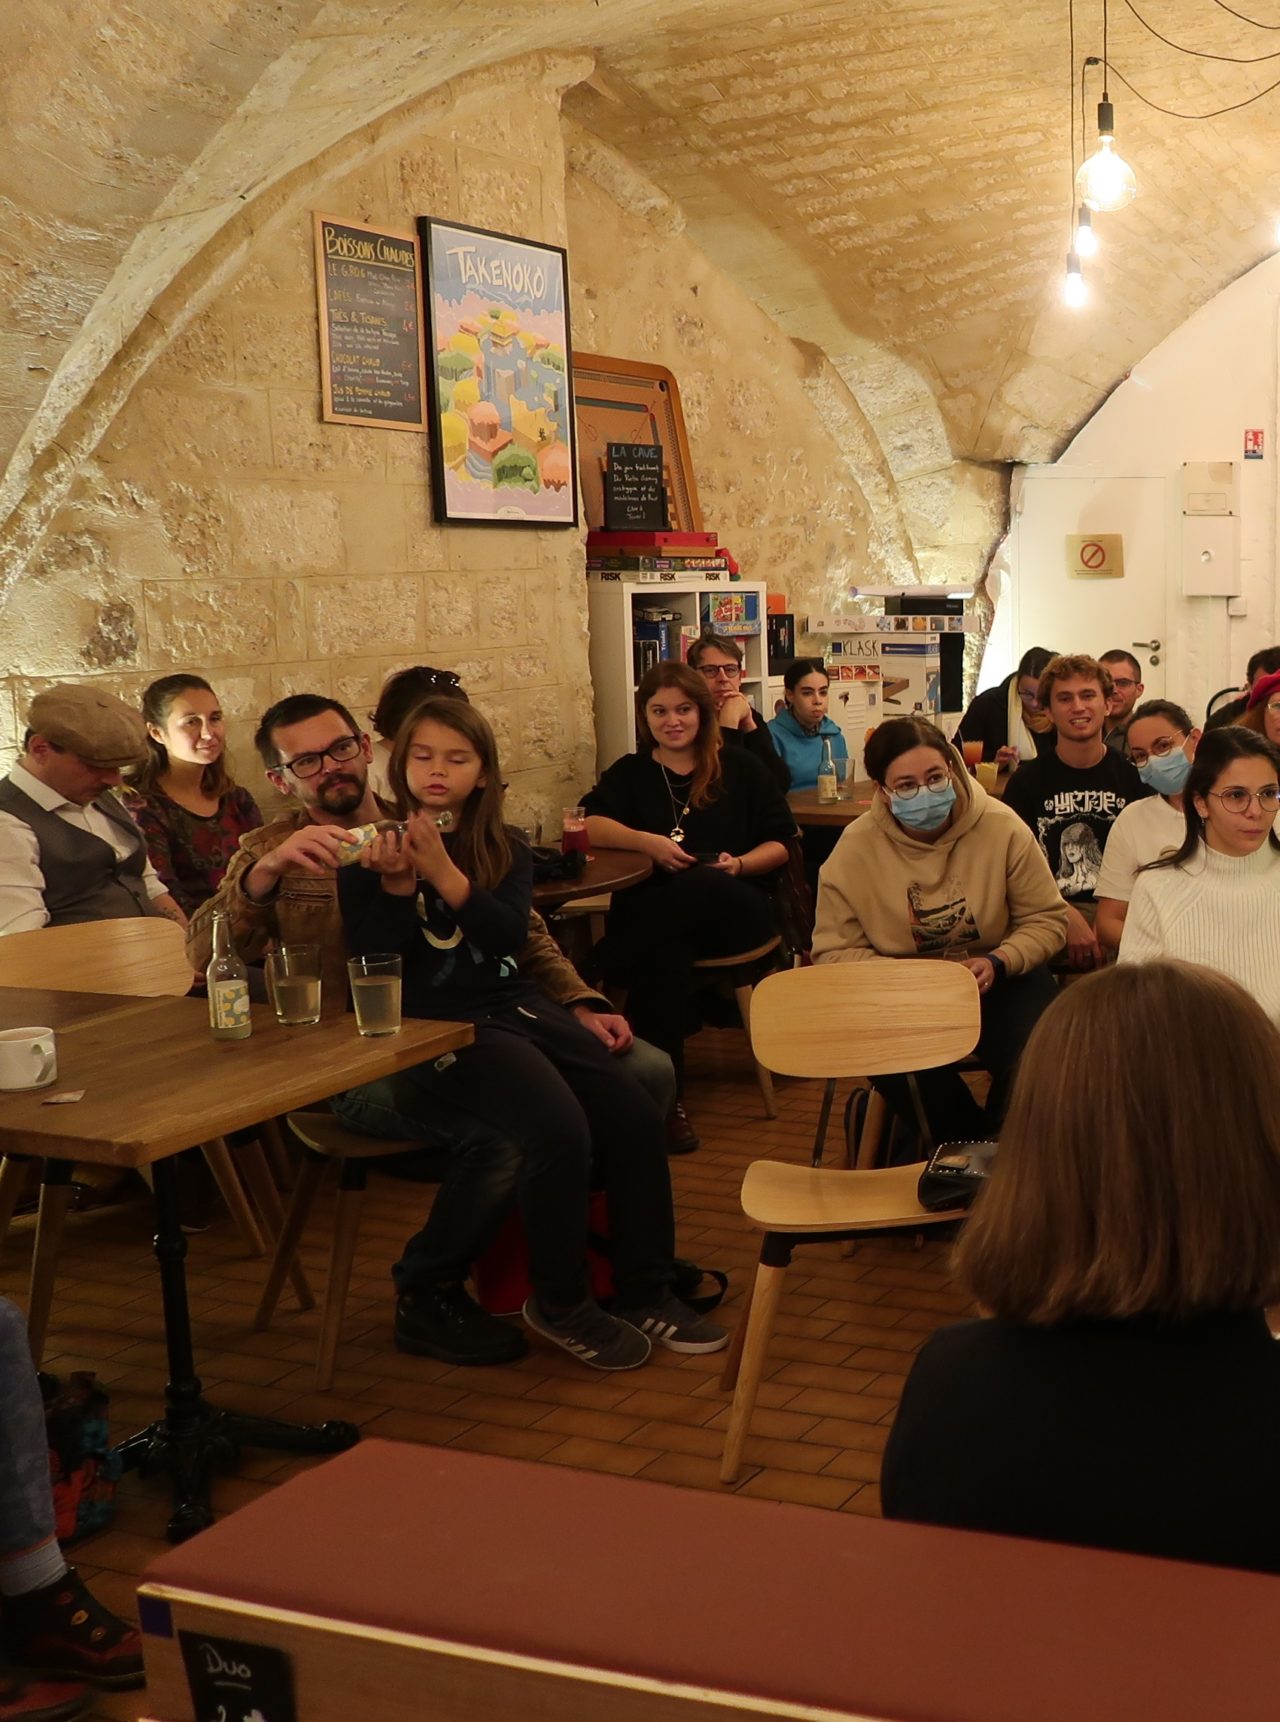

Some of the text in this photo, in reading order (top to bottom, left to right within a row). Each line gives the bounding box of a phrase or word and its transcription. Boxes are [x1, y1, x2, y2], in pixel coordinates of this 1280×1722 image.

[446, 246, 545, 300] TAKENOKO
[612, 446, 658, 458] LA CAVE
[600, 572, 720, 581] RISK RISK RISK
[842, 640, 879, 657] KLASK
[201, 1643, 251, 1678] Duo
